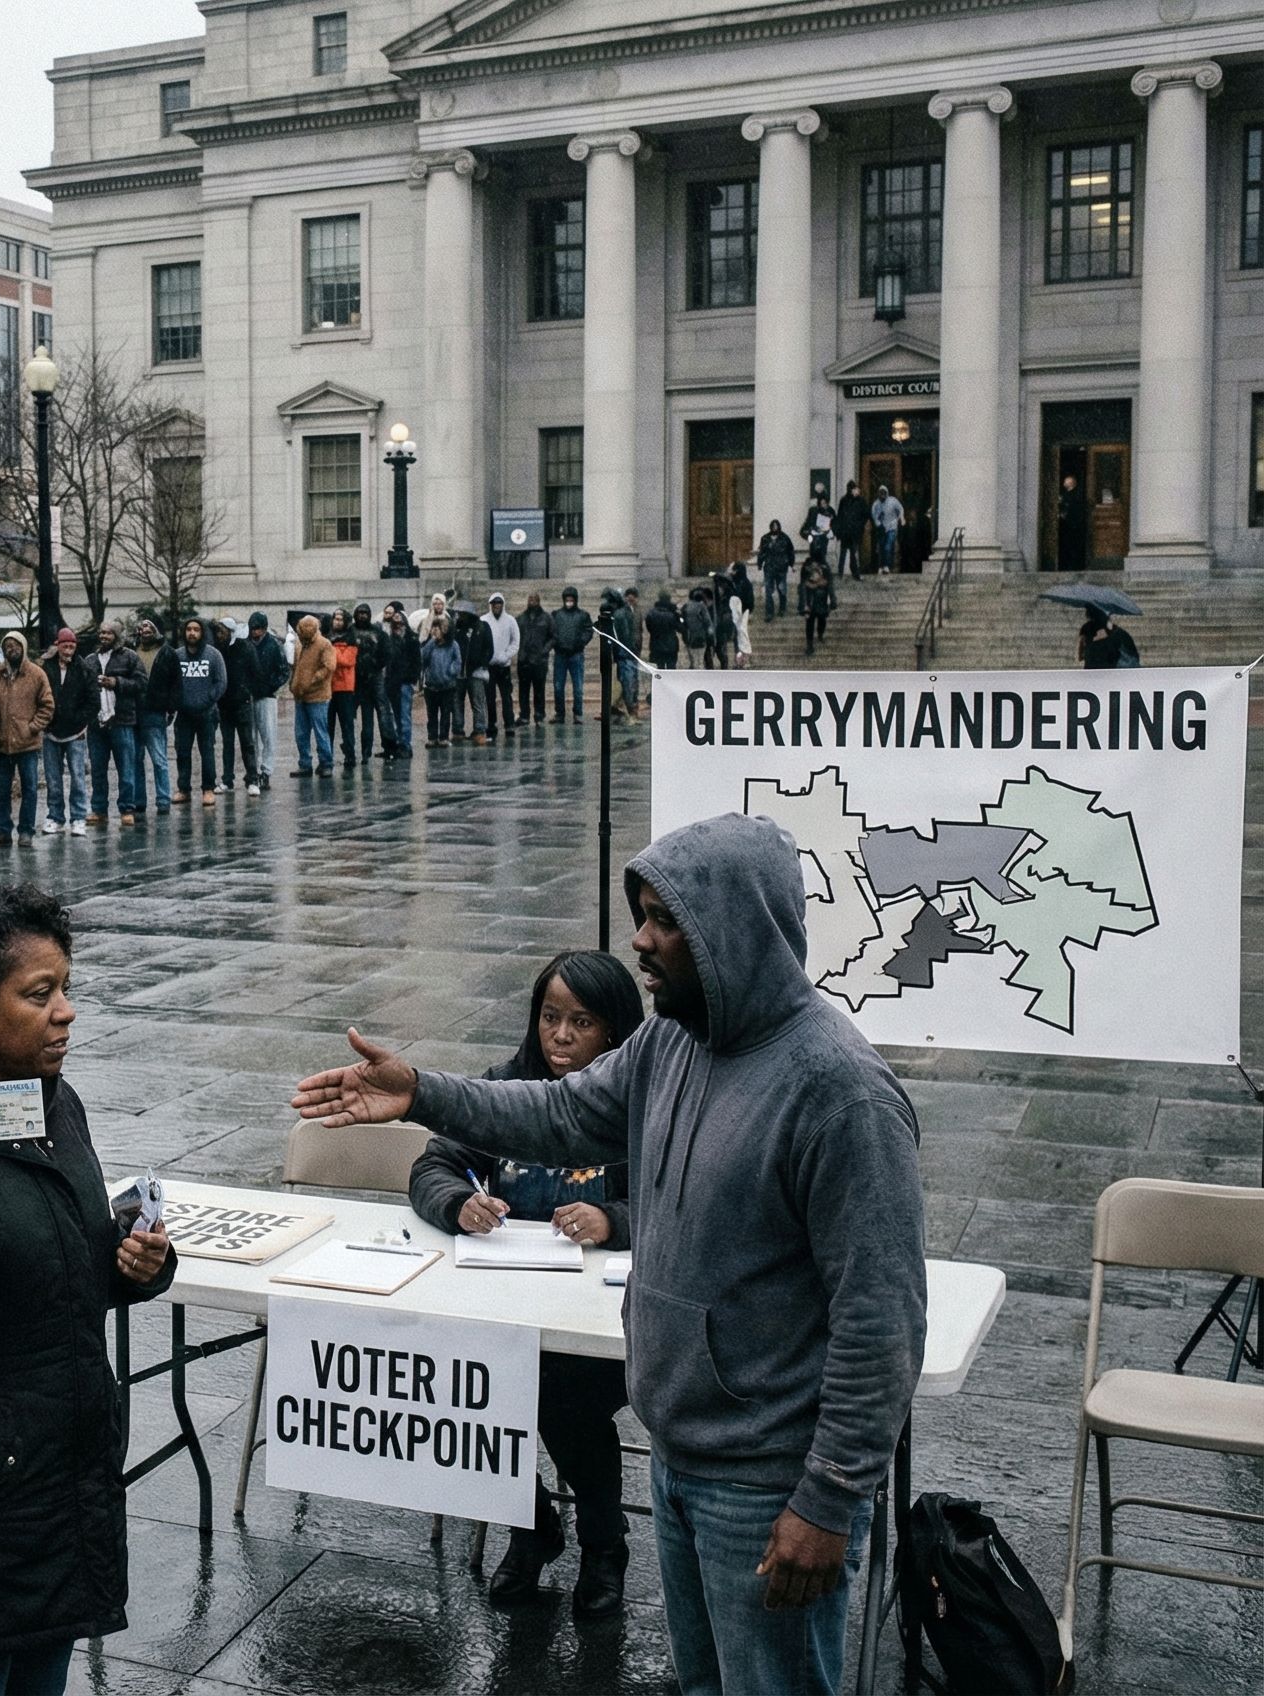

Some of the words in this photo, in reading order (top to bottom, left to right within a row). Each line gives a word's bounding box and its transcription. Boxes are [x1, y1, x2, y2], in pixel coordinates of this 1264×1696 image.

[852, 383, 904, 397] DISTRICT
[907, 381, 940, 394] COUR
[684, 688, 1208, 751] GERRYMANDERING
[164, 1200, 304, 1228] STORE
[310, 1339, 437, 1405] VOTER
[451, 1358, 490, 1411] ID
[275, 1394, 529, 1478] CHECKPOINT
